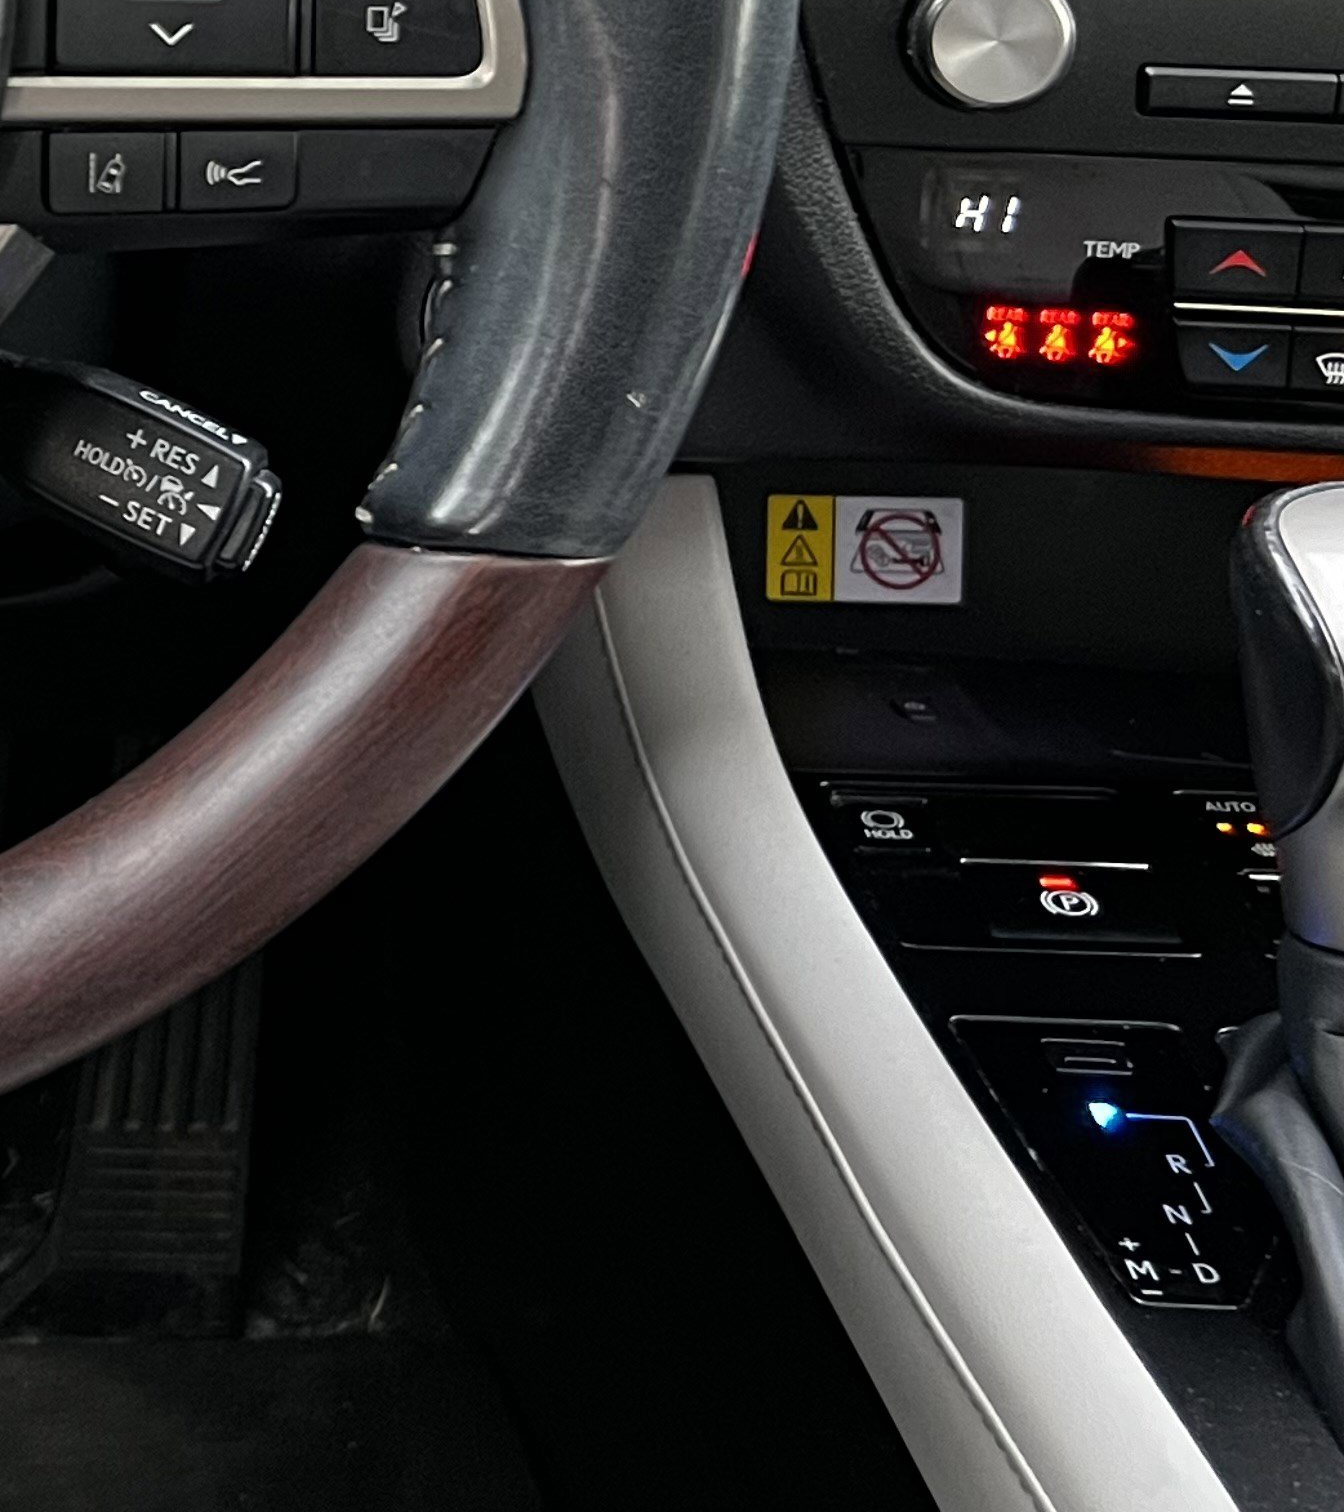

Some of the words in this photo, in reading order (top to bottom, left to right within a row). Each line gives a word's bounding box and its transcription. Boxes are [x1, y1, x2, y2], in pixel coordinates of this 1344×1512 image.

[1083, 240, 1141, 259] TEMP
[139, 390, 230, 440] CANCEL
[73, 439, 126, 475] HOLD
[1205, 800, 1256, 813] AUTO
[863, 828, 913, 840] HOLD
[1165, 1154, 1192, 1175] R
[1162, 1204, 1193, 1225] N
[1124, 1258, 1160, 1281] M
[1192, 1262, 1221, 1284] D
